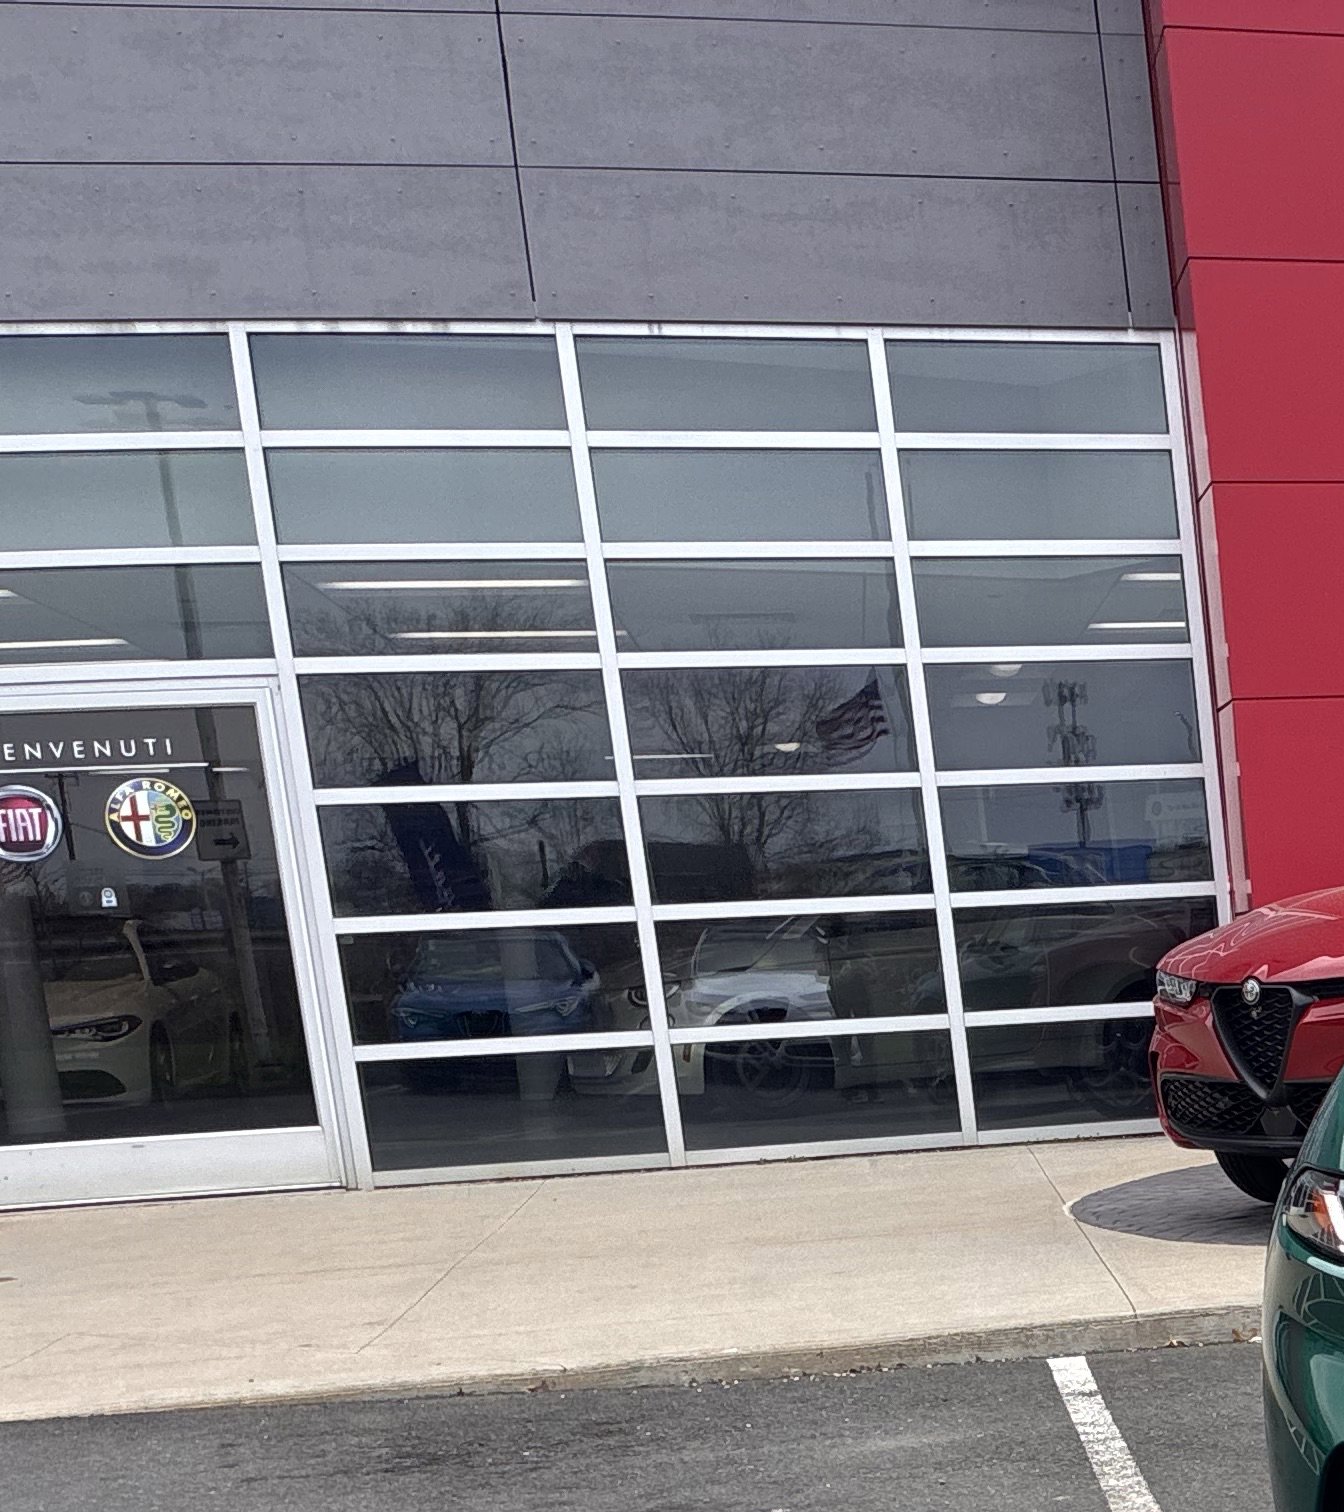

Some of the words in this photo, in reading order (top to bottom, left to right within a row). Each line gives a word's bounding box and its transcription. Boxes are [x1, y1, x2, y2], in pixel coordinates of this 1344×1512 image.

[108, 786, 135, 823] ALFA
[141, 780, 192, 821] ROMEO
[0, 808, 43, 843] FIAT
